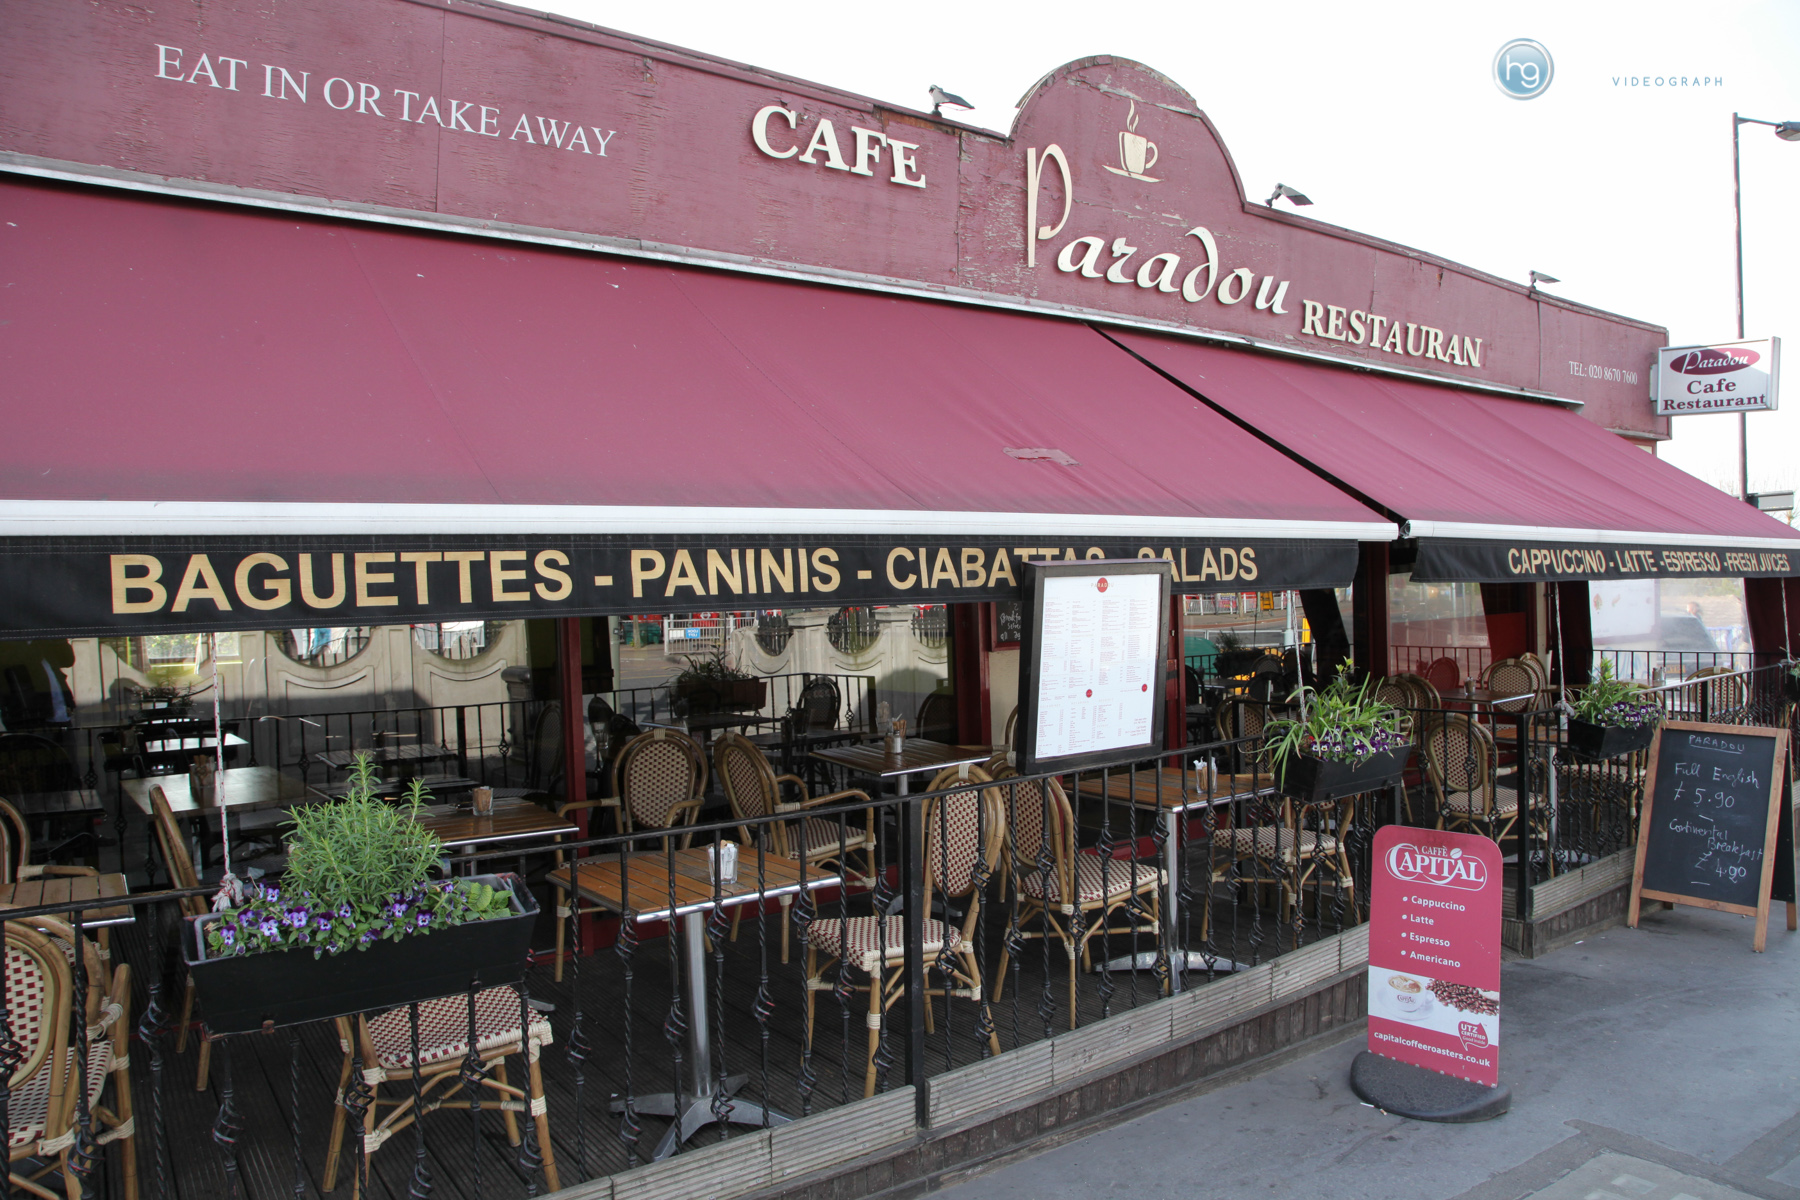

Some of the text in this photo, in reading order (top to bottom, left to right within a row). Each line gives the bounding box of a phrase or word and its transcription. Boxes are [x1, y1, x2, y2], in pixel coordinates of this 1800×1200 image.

[154, 43, 617, 157] EAT IN OR TAKE AWAY
[751, 104, 926, 189] CAFE
[1027, 143, 1290, 315] Paradou
[1301, 299, 1483, 368] RESTAURAN
[1569, 360, 1639, 385] TEL: 020 8670 7600
[1681, 350, 1750, 374] Paradou
[1686, 378, 1736, 395] Cafe
[1663, 394, 1766, 411] Restaurant
[1508, 547, 1606, 575] CAPPUCCINO
[1615, 550, 1658, 573] LATTE
[1759, 553, 1791, 572] JUICES
[110, 549, 573, 614] BAGUETTES
[629, 548, 841, 598] PANINIS
[1688, 734, 1745, 752] PARADOU
[1675, 762, 1760, 789] Full English
[1389, 842, 1485, 885] CAPITAL
[1411, 895, 1466, 912] Cappuccino
[1410, 913, 1435, 926] Latte
[1409, 932, 1451, 947] Espresso
[1409, 950, 1461, 968] Americano
[1461, 1023, 1478, 1034] UTZ
[1461, 1030, 1486, 1040] CERTIFIED
[1373, 1031, 1491, 1068] capitalcoffeeroasters.co.uk
